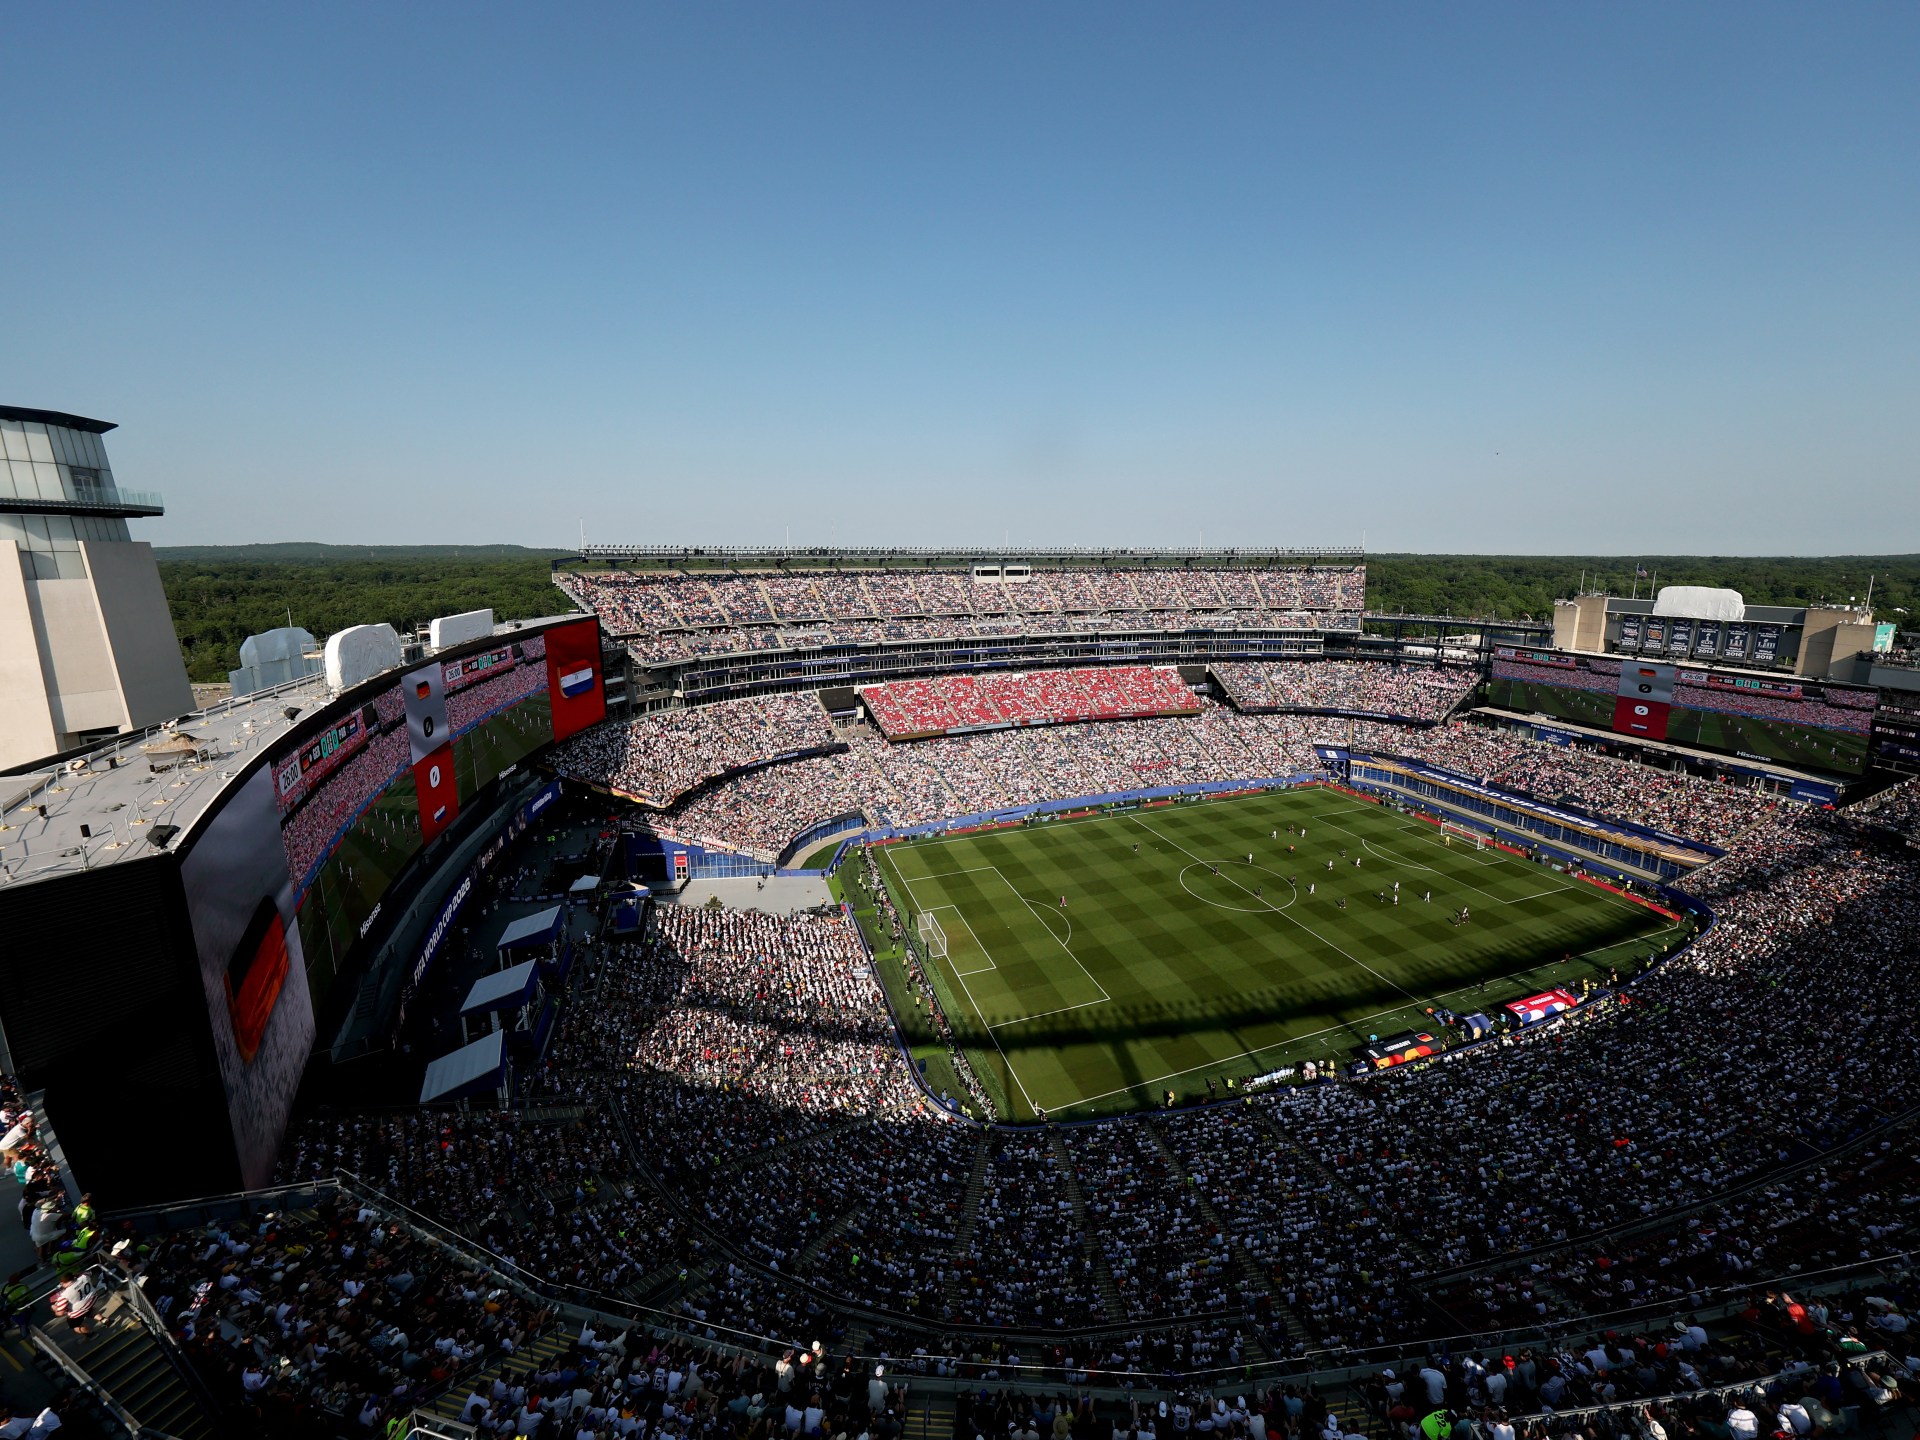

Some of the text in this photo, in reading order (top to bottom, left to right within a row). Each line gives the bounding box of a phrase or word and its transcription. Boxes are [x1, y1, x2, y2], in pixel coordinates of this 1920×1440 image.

[1684, 673, 1704, 681] 26:00
[1875, 726, 1916, 739] BOSTON
[1736, 750, 1772, 763] Hisense
[282, 763, 299, 790] 26:00
[499, 764, 517, 780] Hisense
[1419, 770, 1600, 828] FIFA WORLD CUP 2026
[359, 902, 382, 940] Hisense
[413, 876, 471, 987] FIFA WORLD CUP 2026
[1383, 1039, 1412, 1052] GERMANY
[78, 1282, 91, 1301] 10
[1433, 1412, 1447, 1429] 22
